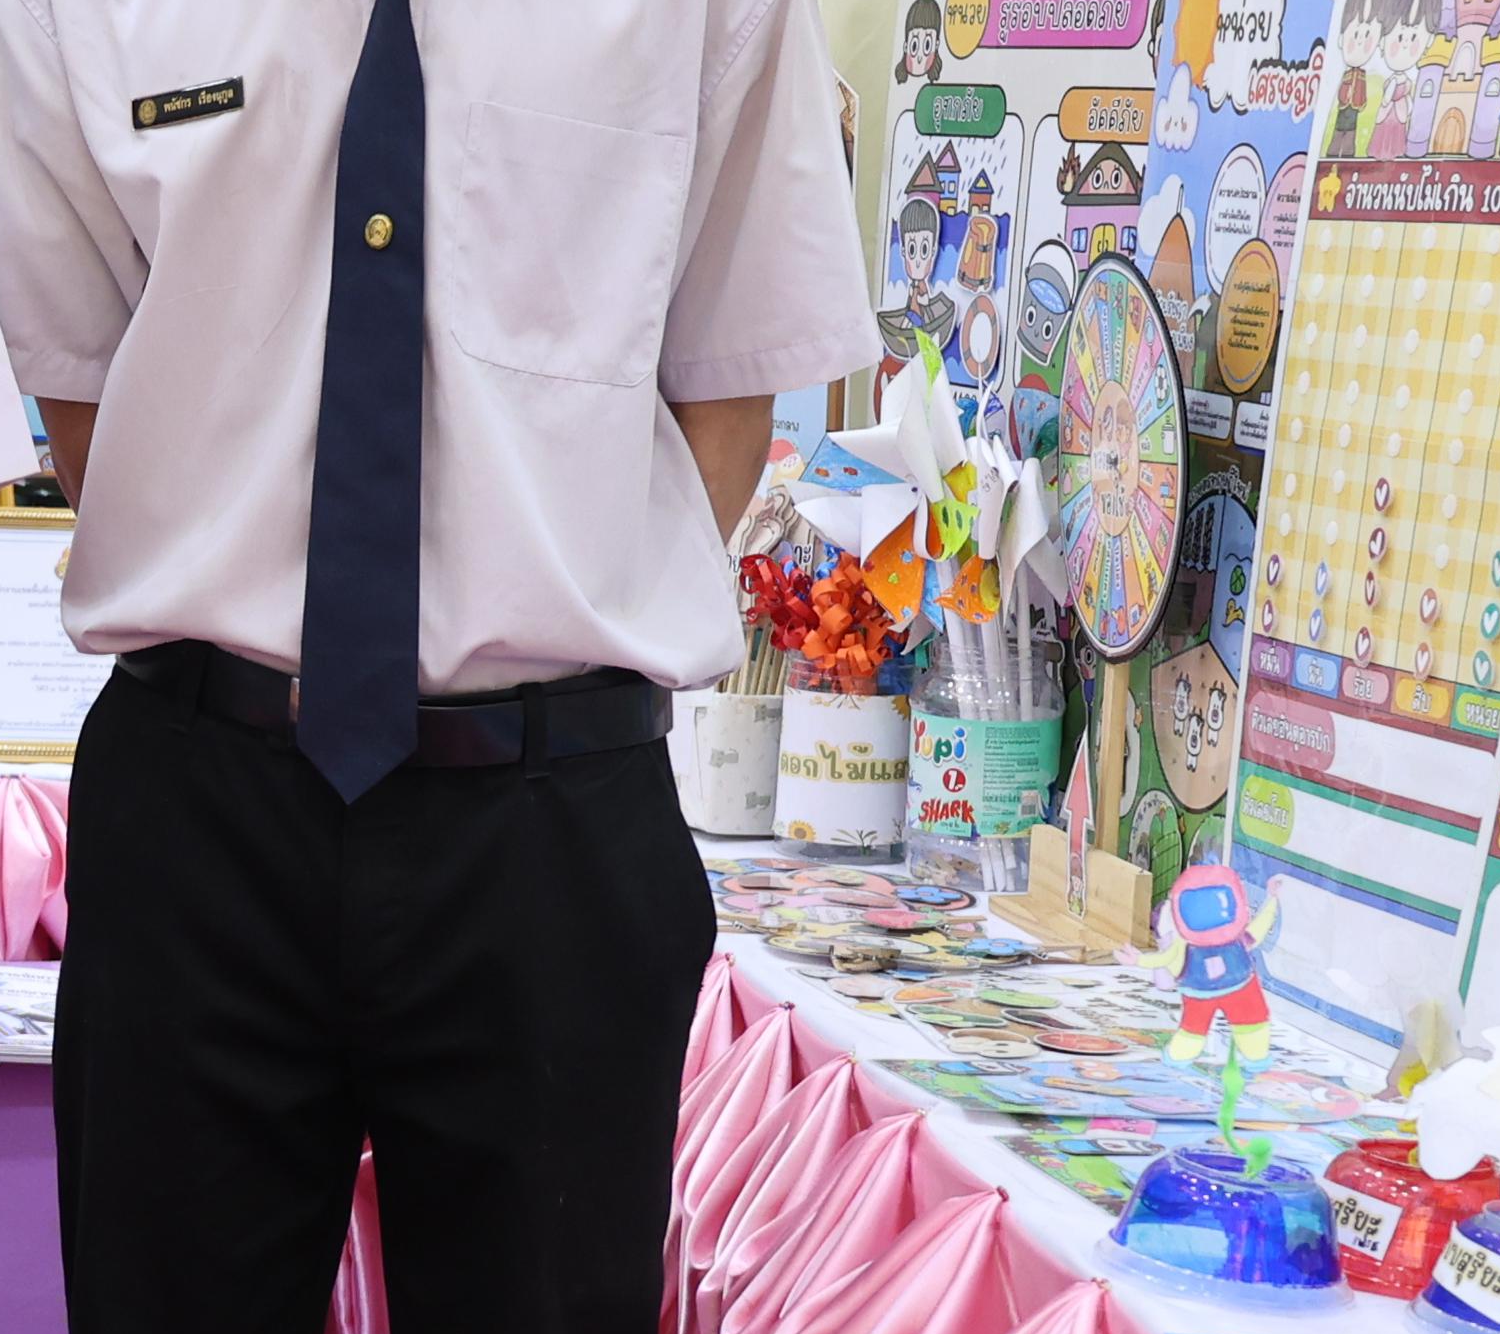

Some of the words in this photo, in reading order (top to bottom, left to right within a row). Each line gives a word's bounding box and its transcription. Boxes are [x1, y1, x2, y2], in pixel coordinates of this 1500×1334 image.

[1249, 51, 1326, 121] เศรษฐกิ
[1088, 100, 1143, 133] อัคคีภัย
[1345, 167, 1474, 215] จำนวนนับไม่เกิน
[912, 715, 967, 766] Yupi
[918, 798, 976, 824] SHARK
